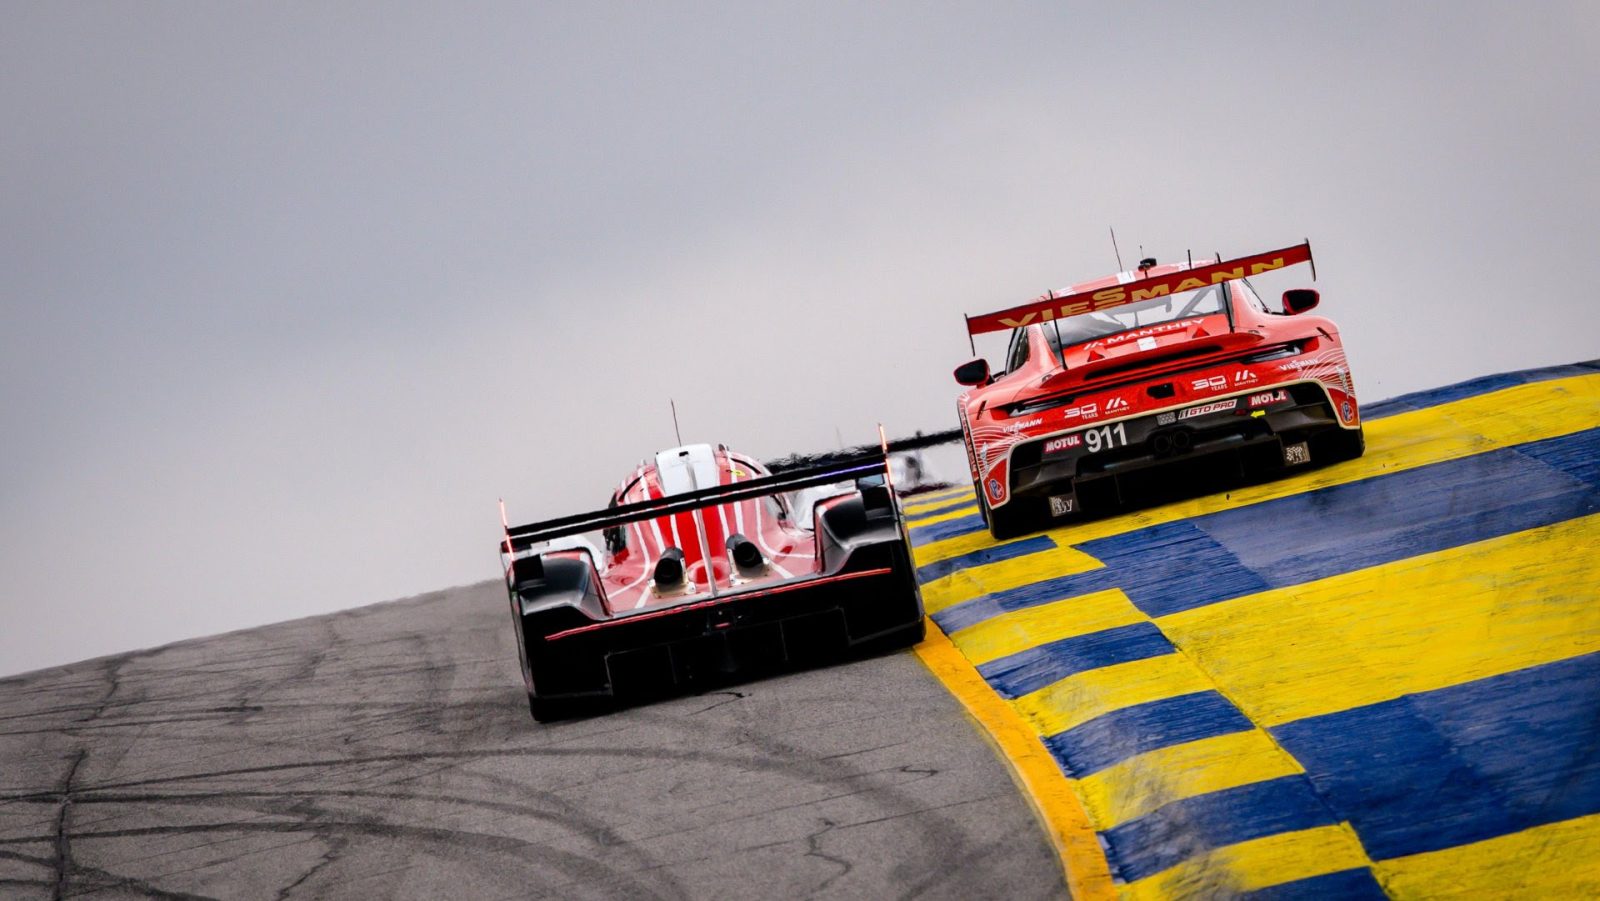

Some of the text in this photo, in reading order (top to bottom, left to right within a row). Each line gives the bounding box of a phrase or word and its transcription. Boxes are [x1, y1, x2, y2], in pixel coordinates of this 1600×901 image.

[1106, 318, 1205, 344] MANTHEY
[1189, 401, 1235, 416] GTD PRO
[1045, 436, 1080, 452] MOTUL
[1085, 422, 1128, 453] 911
